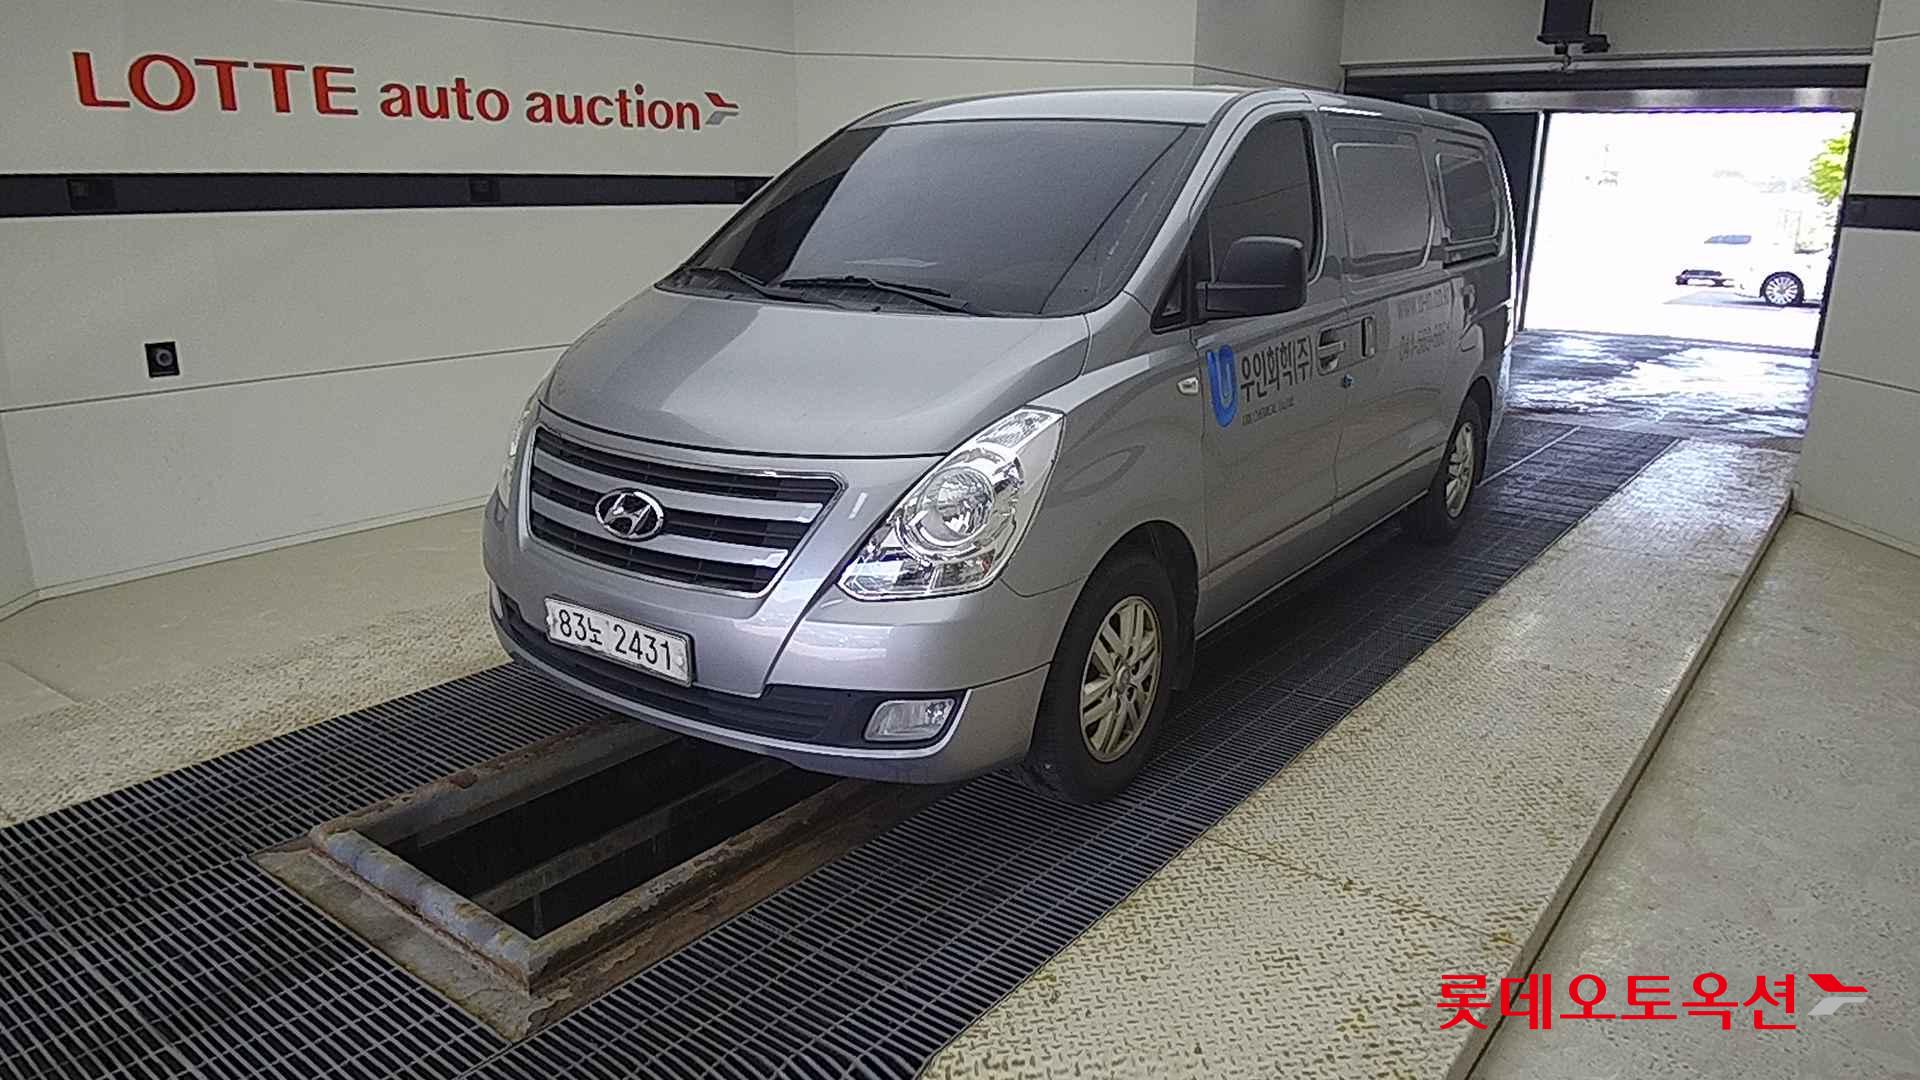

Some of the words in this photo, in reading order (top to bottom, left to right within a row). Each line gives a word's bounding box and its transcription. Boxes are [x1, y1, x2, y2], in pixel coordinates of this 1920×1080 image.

[73, 52, 358, 116] LOTTE
[378, 78, 508, 122] auto
[526, 86, 701, 131] auction
[559, 609, 603, 644] 83노
[613, 624, 671, 670] 2431
